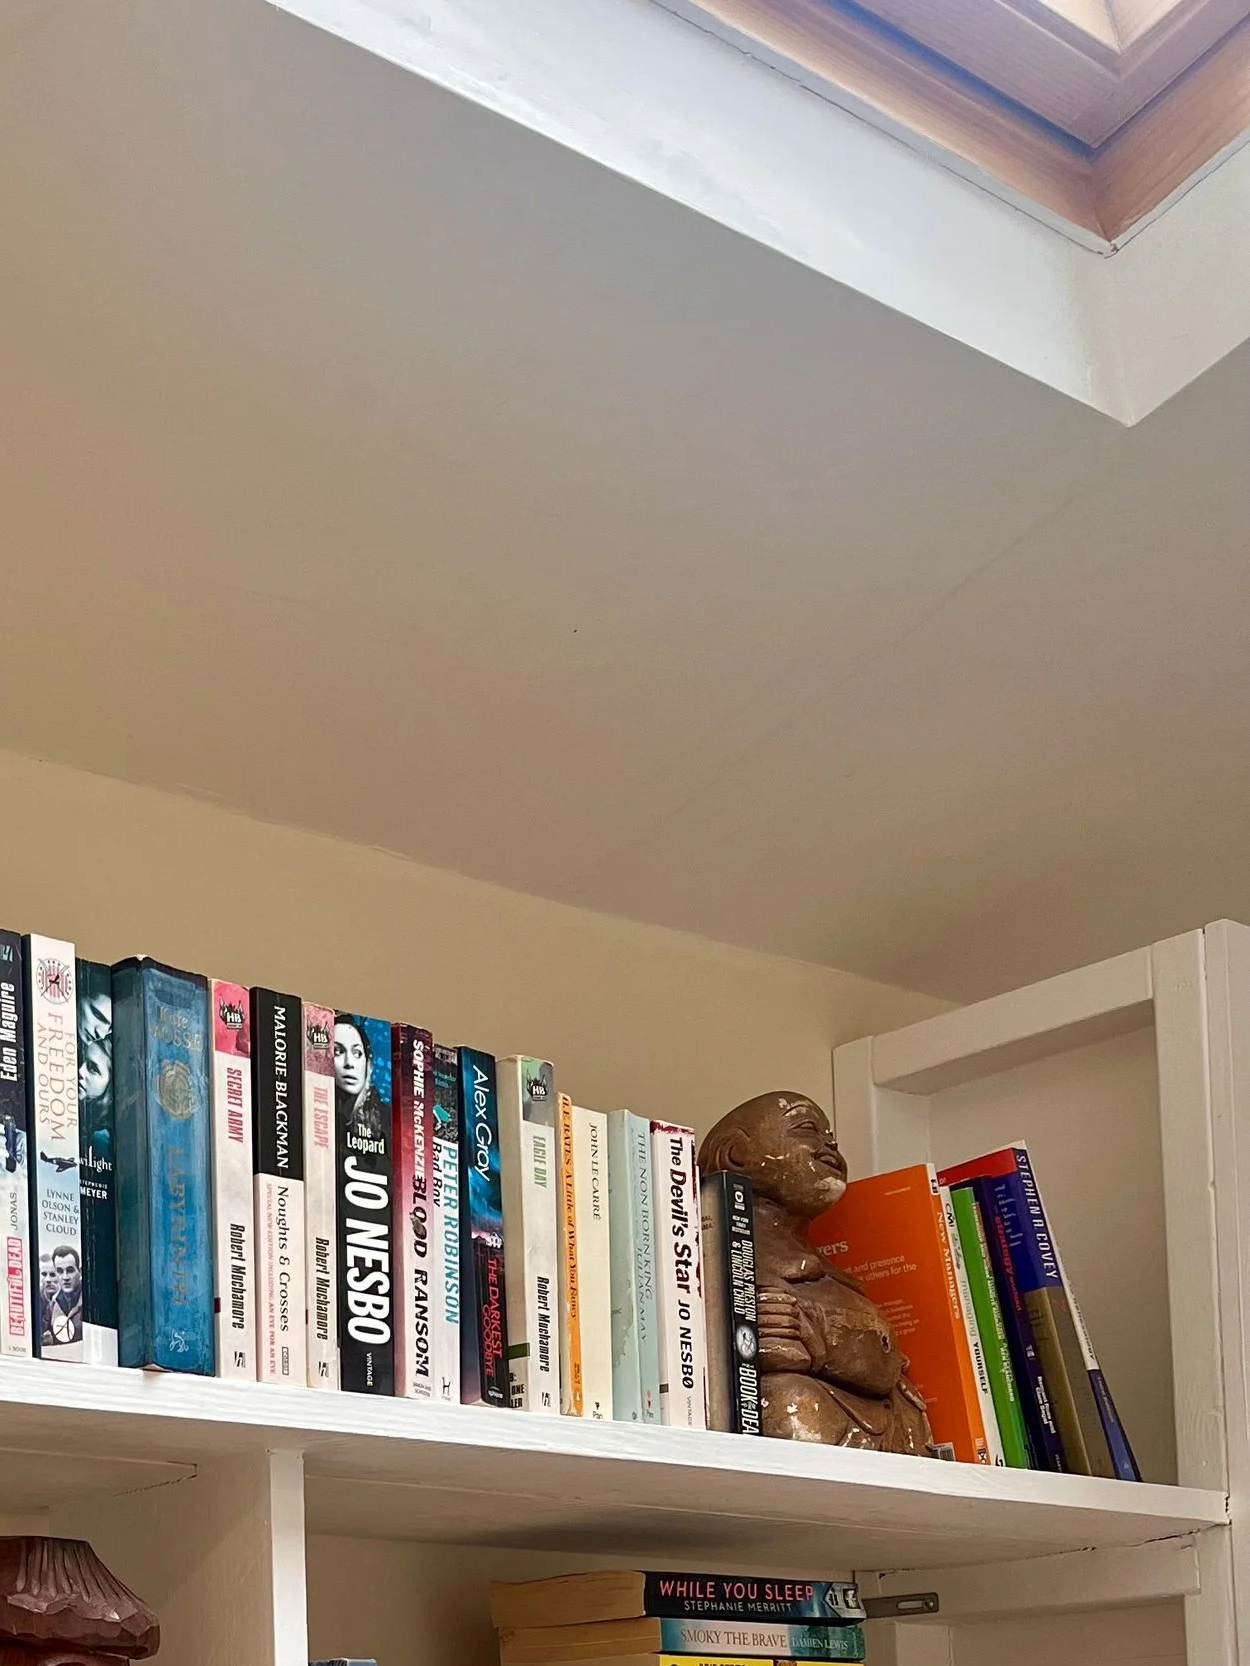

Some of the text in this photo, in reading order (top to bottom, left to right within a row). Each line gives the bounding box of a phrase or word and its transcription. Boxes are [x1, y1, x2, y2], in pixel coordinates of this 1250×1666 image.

[357, 1122, 372, 1139] The
[472, 1064, 493, 1183] Alex Gray
[346, 1131, 385, 1155] Leopard
[344, 1155, 390, 1211] JO
[46, 1188, 75, 1202] LYNNE
[41, 1199, 72, 1214] OLSON
[670, 1136, 692, 1295] The Devil's Star
[43, 1211, 80, 1226] STANLEY
[46, 1223, 77, 1237] CLOUD
[230, 1222, 246, 1331] Robert Muchamore
[678, 1298, 693, 1324] JO
[659, 1580, 815, 1601] WHILE YOU SLEEP
